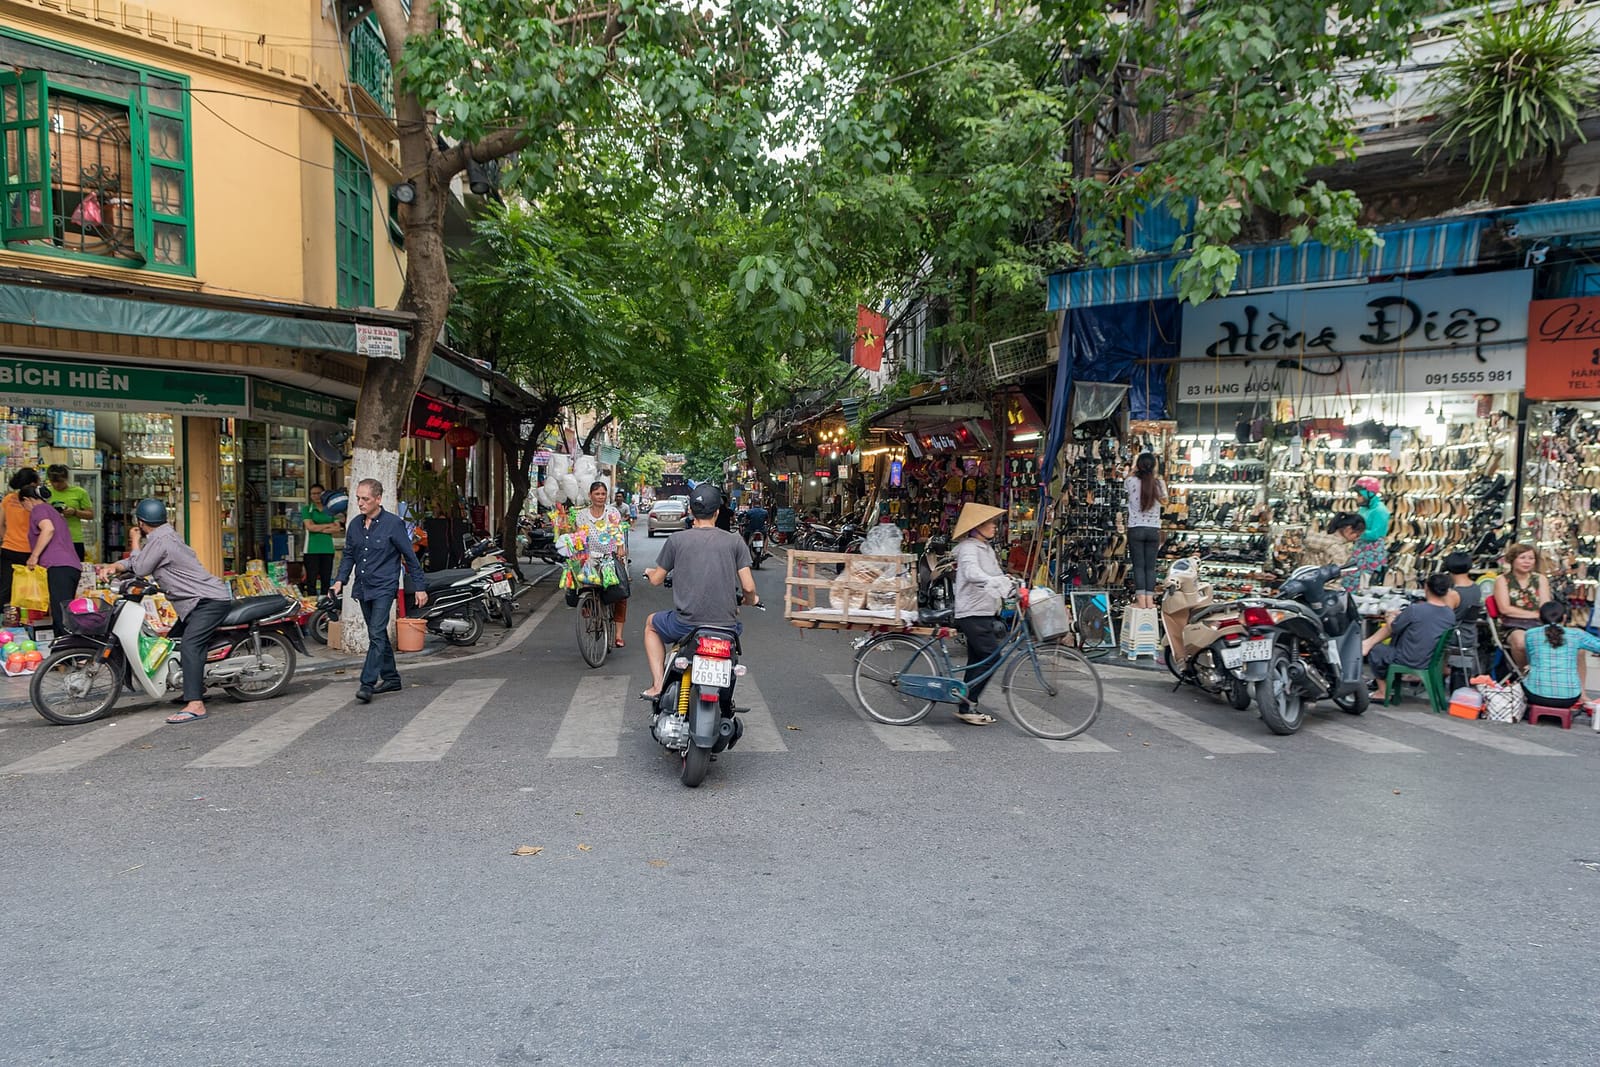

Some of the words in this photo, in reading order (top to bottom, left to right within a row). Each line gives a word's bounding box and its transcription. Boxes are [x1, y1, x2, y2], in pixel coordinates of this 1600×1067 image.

[1206, 305, 1344, 376] Hồng
[1359, 295, 1500, 363] Điệp
[0, 363, 60, 387] BÍCH
[69, 367, 129, 391] HIỀN
[1426, 375, 1448, 384] 091
[1452, 372, 1484, 383] 5555
[1488, 370, 1512, 381] 981
[1187, 386, 1200, 395] 83
